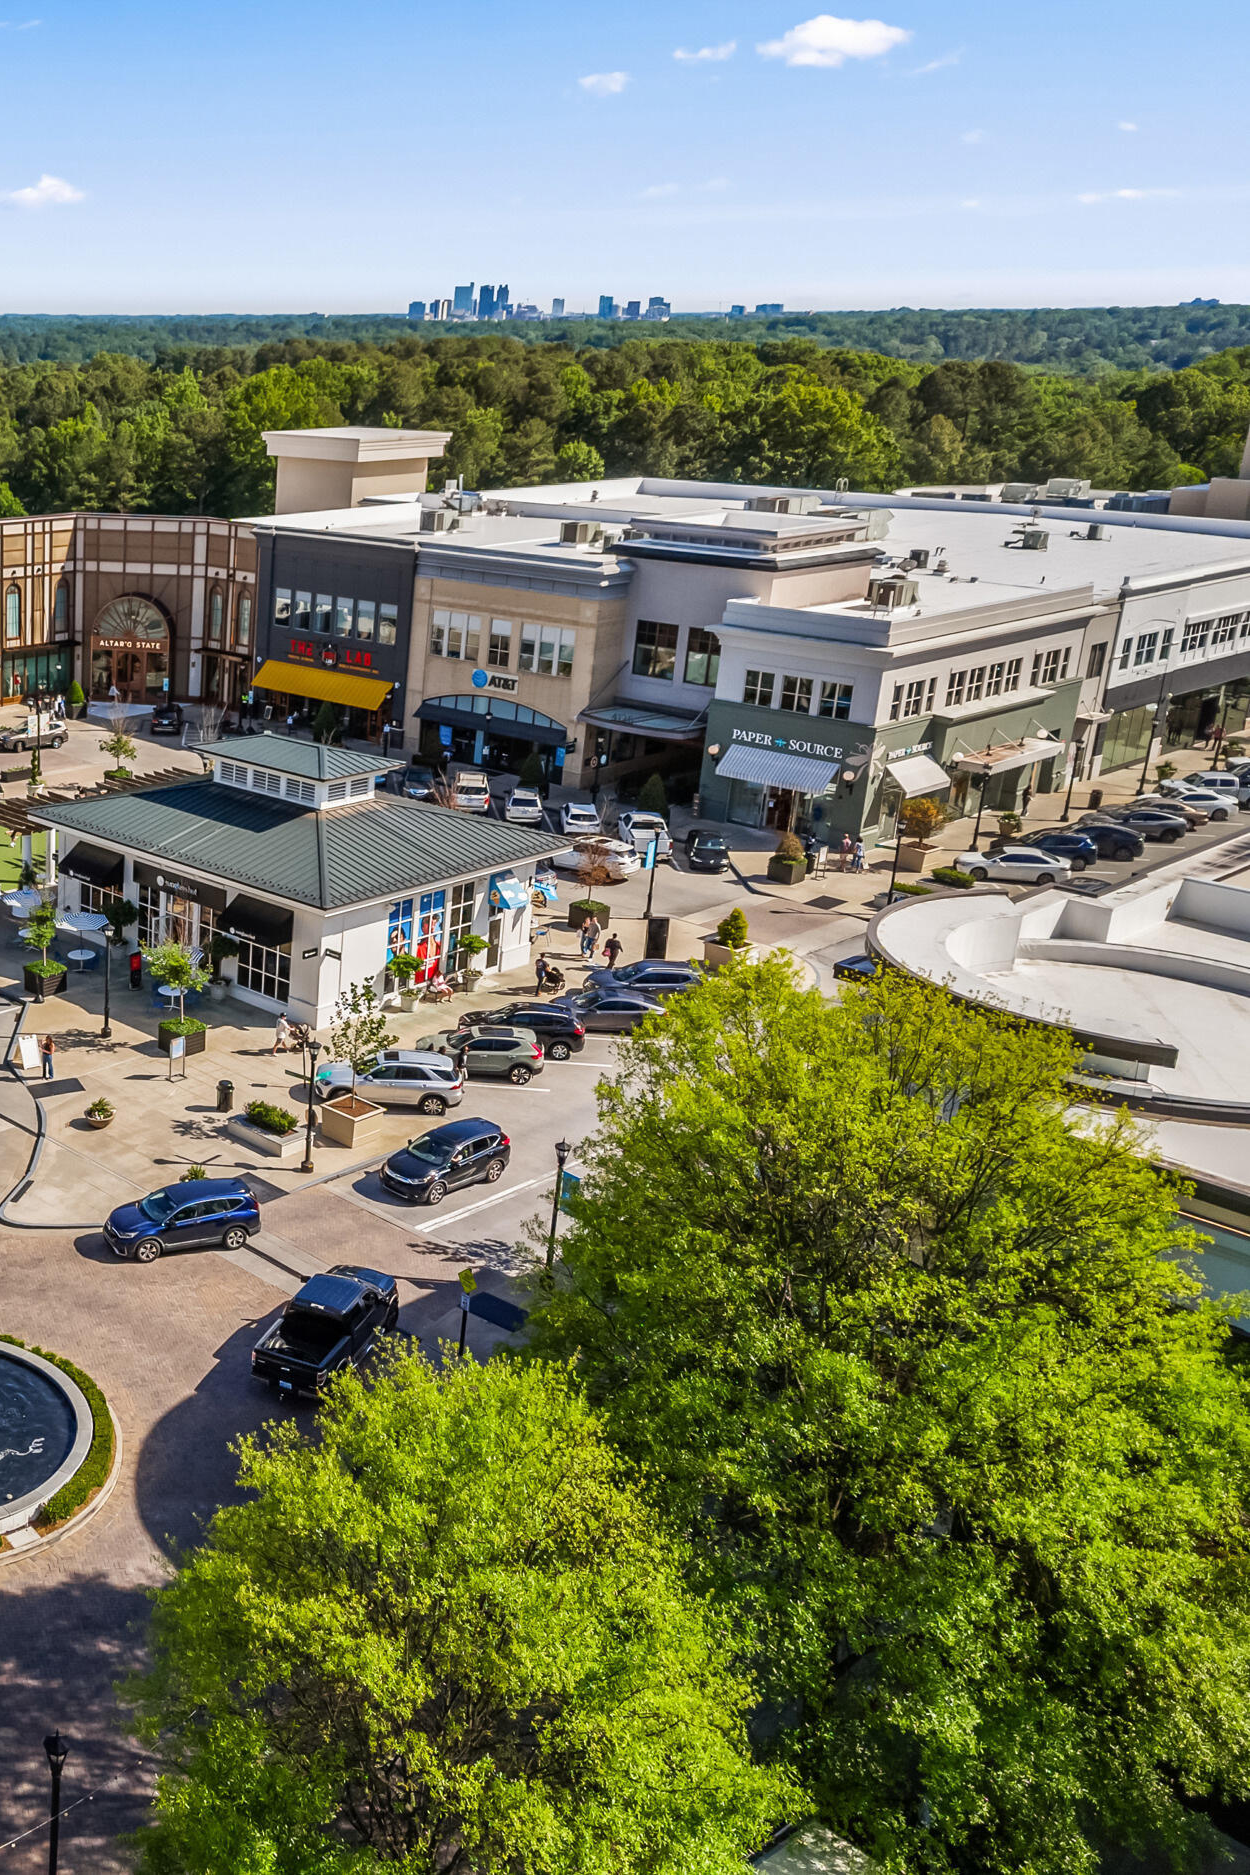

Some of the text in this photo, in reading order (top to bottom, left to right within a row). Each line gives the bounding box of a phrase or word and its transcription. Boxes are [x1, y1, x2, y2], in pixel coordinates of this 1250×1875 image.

[136, 642, 161, 650] STATE
[291, 640, 314, 656] THE
[488, 675, 518, 691] AT&T
[732, 729, 842, 759] PAPER SOURCE
